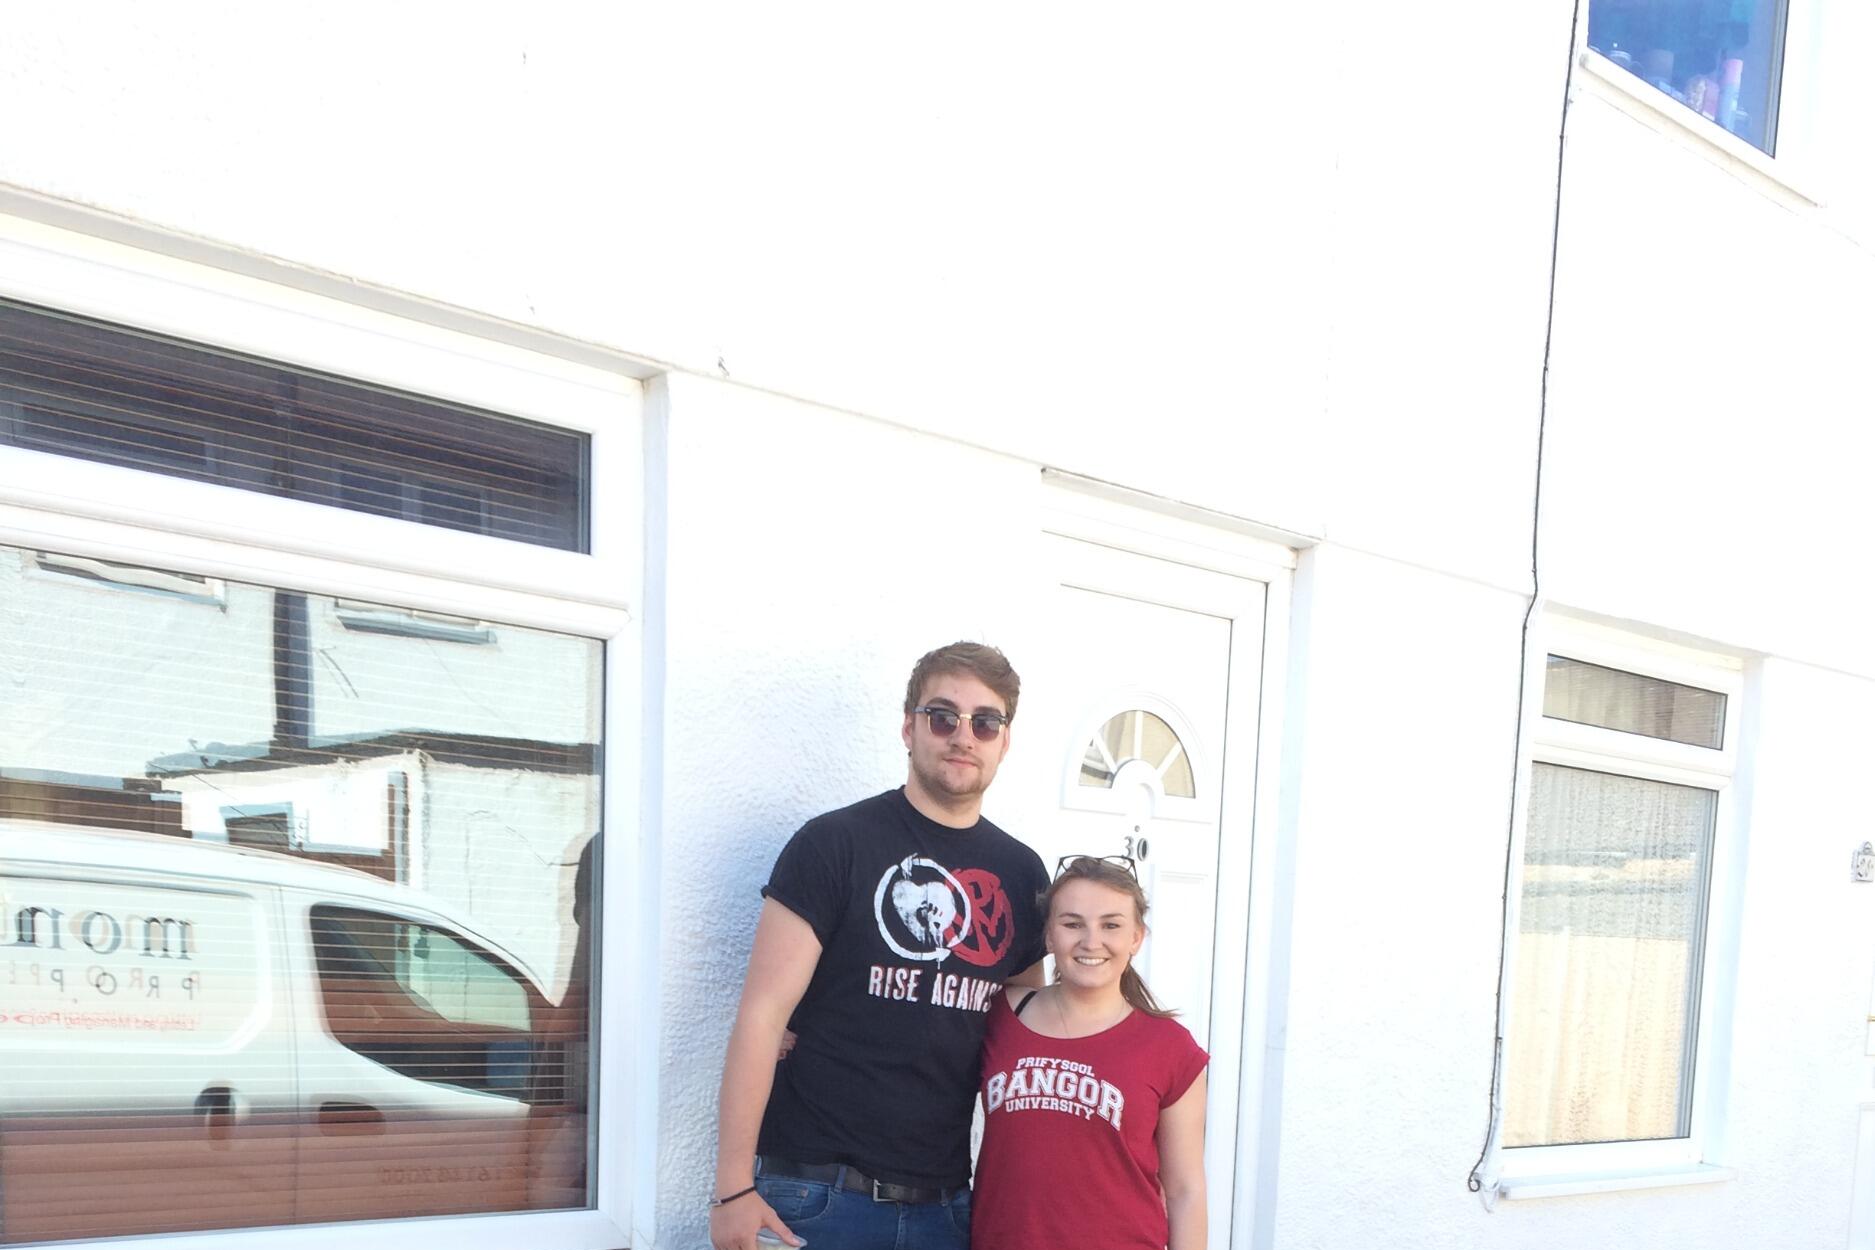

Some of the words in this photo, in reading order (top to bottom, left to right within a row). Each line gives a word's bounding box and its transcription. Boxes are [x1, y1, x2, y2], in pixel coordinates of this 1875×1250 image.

[1121, 835, 1149, 863] 30
[867, 966, 923, 1002] RISE
[930, 972, 1003, 1013] AGAINS
[1016, 1056, 1095, 1078] PRIFYSGOL
[987, 1068, 1125, 1131] BANGOR
[1005, 1097, 1095, 1121] UNIVERSITY
